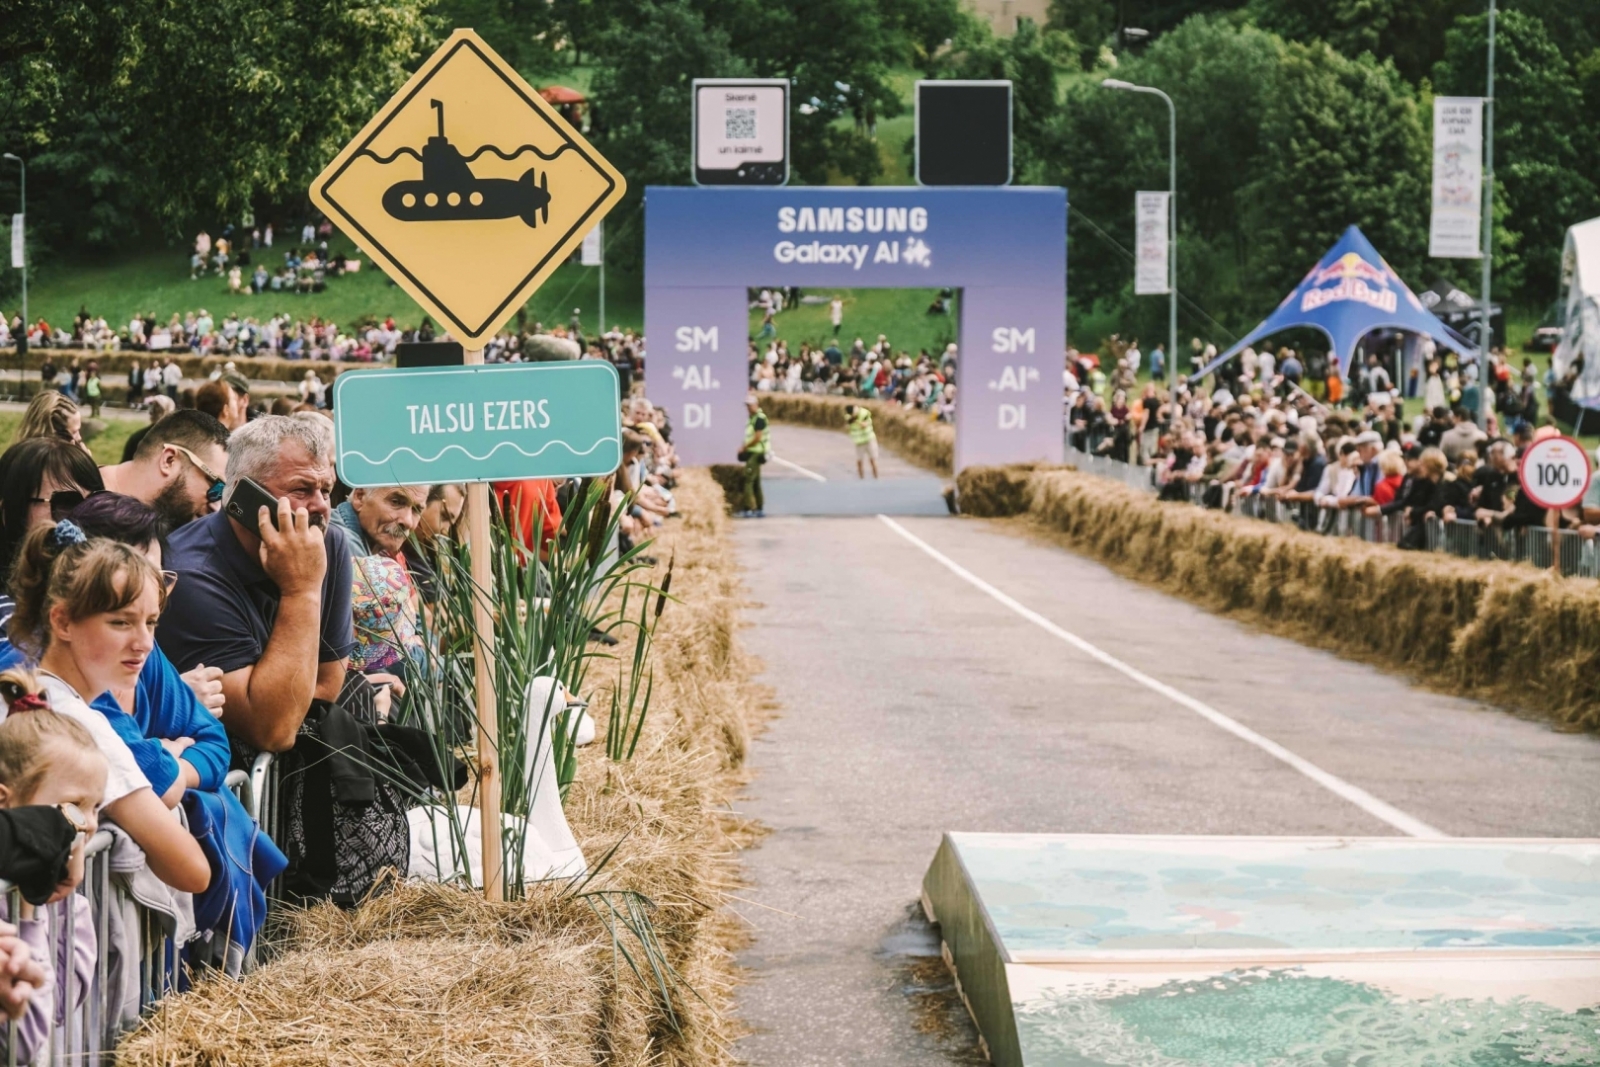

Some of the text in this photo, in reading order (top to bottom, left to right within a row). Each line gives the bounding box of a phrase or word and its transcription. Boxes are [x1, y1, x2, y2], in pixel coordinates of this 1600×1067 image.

[778, 206, 928, 232] SAMSUNG
[774, 240, 899, 270] Galaxy AI
[675, 326, 719, 352] SM
[992, 327, 1035, 354] SM
[406, 399, 551, 434] TALSU EZERS
[684, 403, 711, 428] DI
[999, 404, 1026, 429] DI
[1537, 463, 1569, 486] 100
[357, 823, 379, 850] NIKE
[339, 841, 359, 866] NIKE
[366, 842, 386, 868] NIKE
